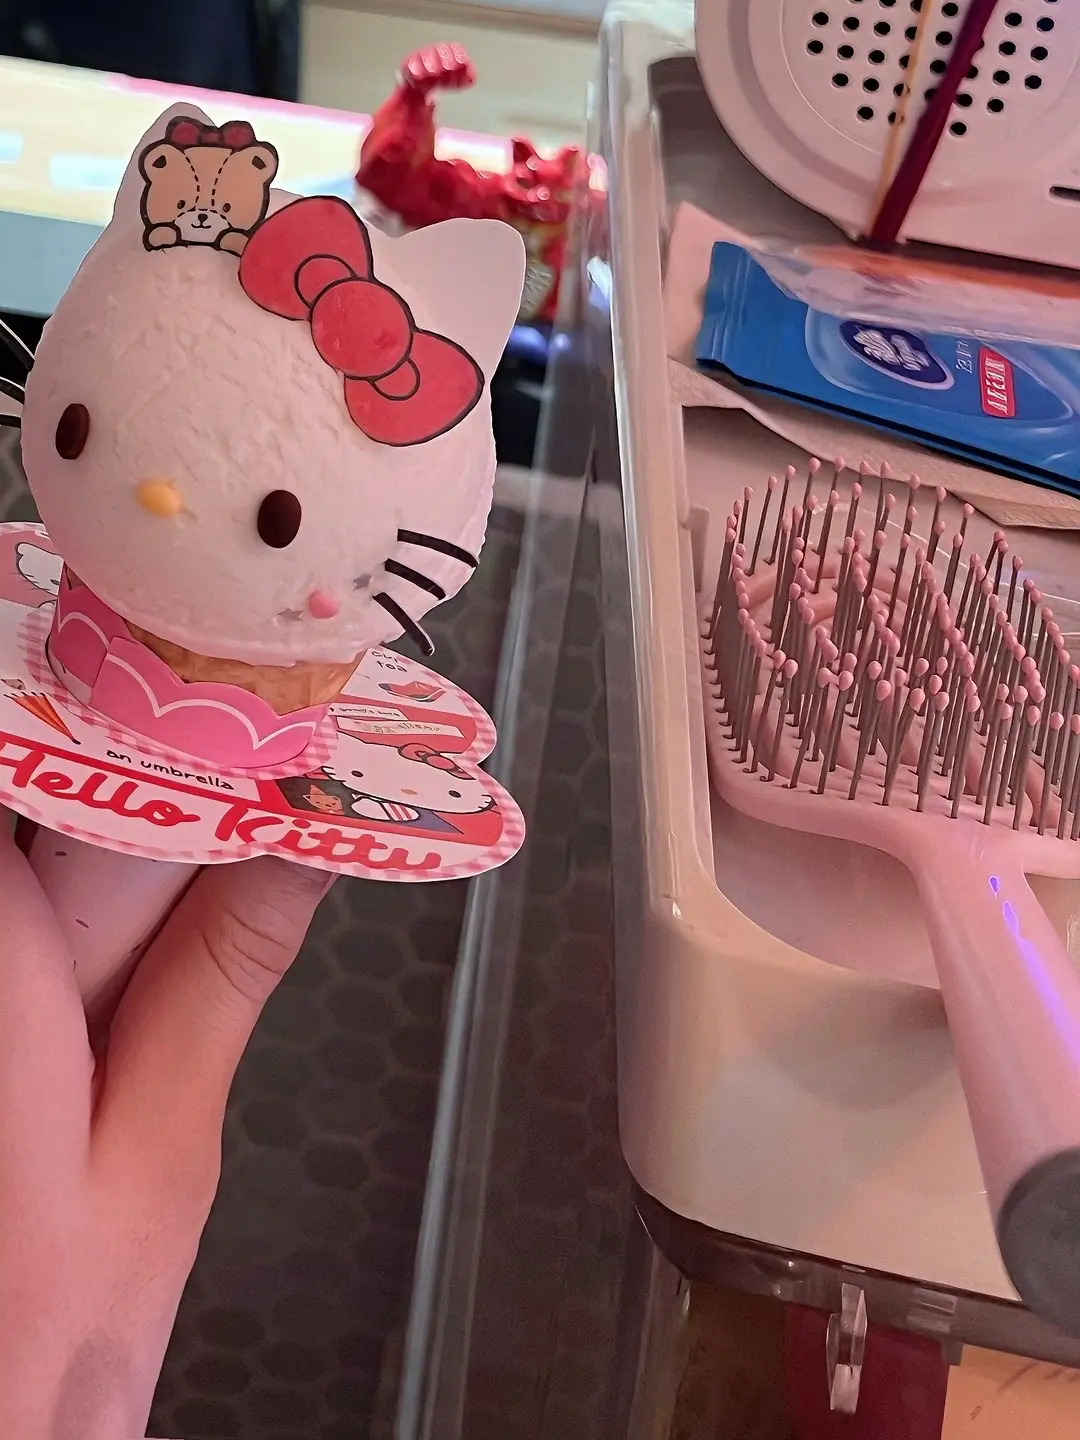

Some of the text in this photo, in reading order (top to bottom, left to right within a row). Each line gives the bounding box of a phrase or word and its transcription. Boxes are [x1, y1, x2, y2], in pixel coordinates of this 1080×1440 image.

[106, 749, 235, 790] an umbrella
[214, 801, 443, 871] Kitty
